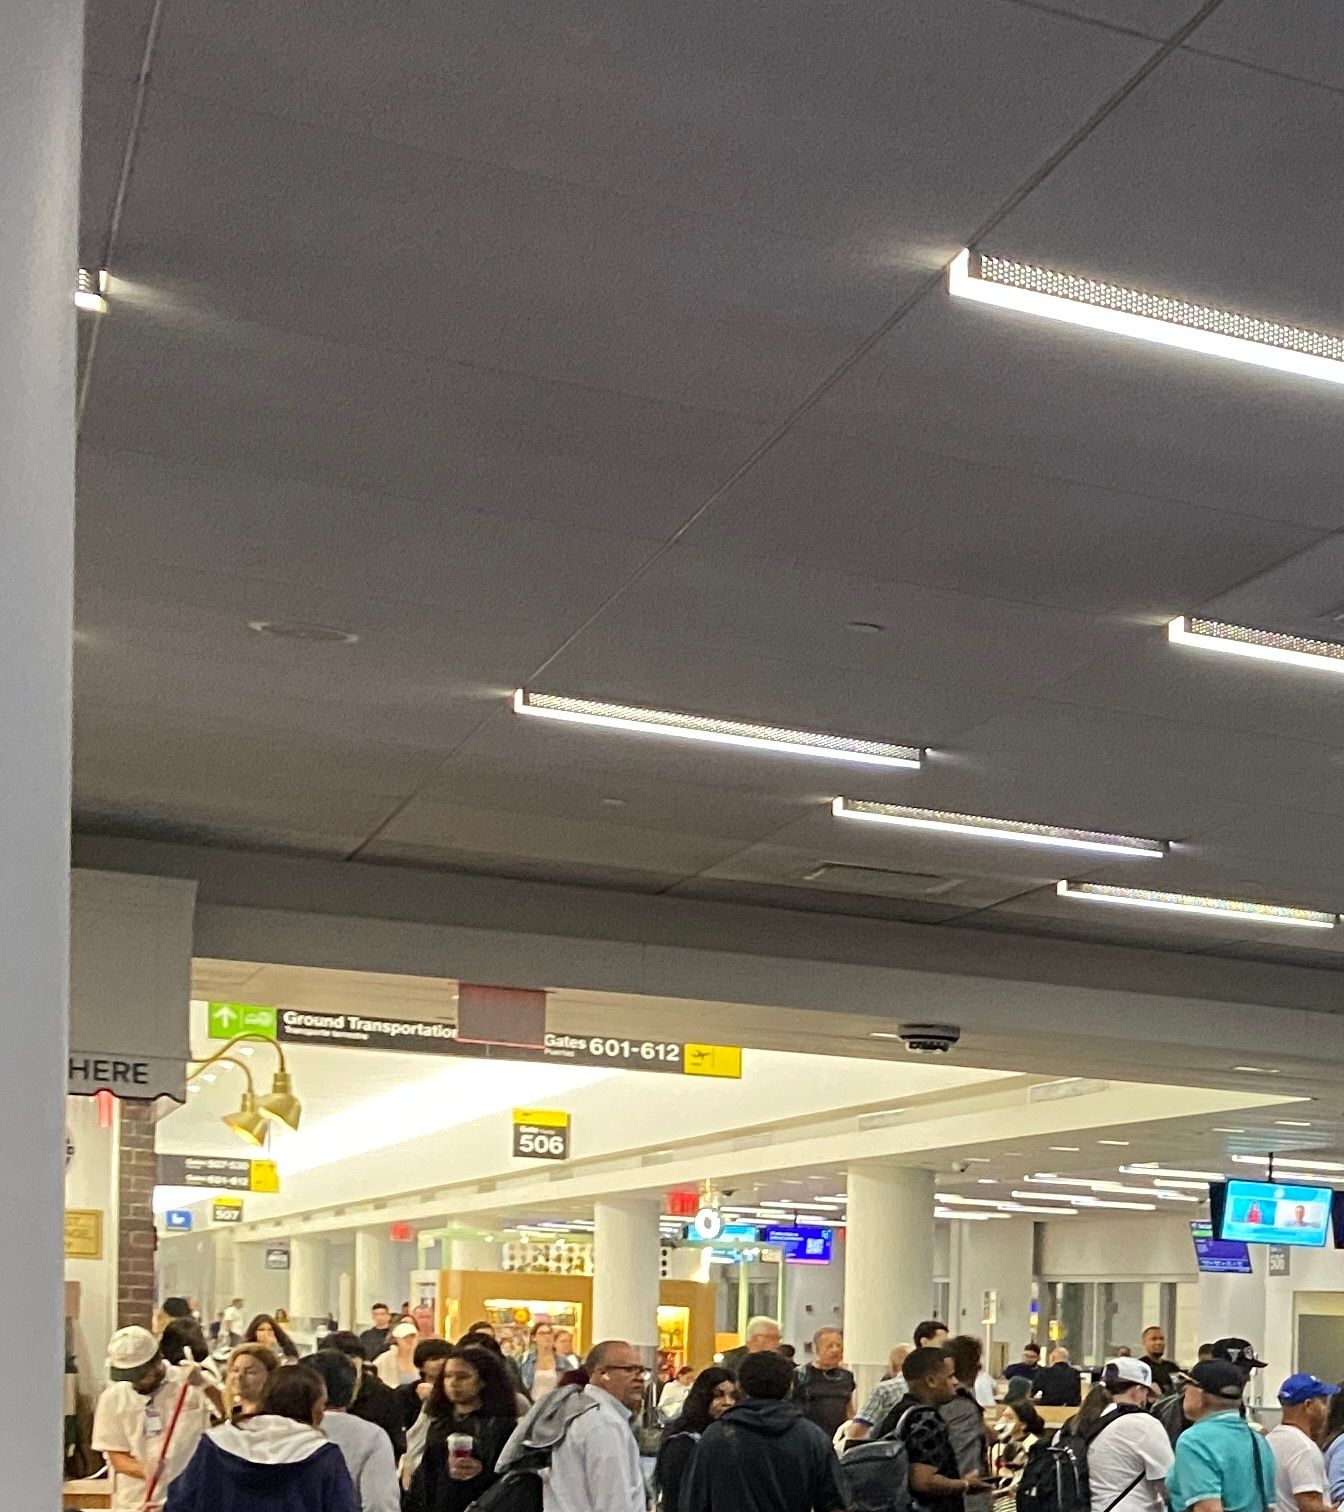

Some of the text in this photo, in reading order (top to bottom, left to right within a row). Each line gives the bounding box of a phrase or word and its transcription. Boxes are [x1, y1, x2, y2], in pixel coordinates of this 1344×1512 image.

[283, 1011, 345, 1029] Ground
[544, 1033, 680, 1062] Gates 601-612
[69, 1058, 149, 1084] HERE
[519, 1134, 564, 1155] 506
